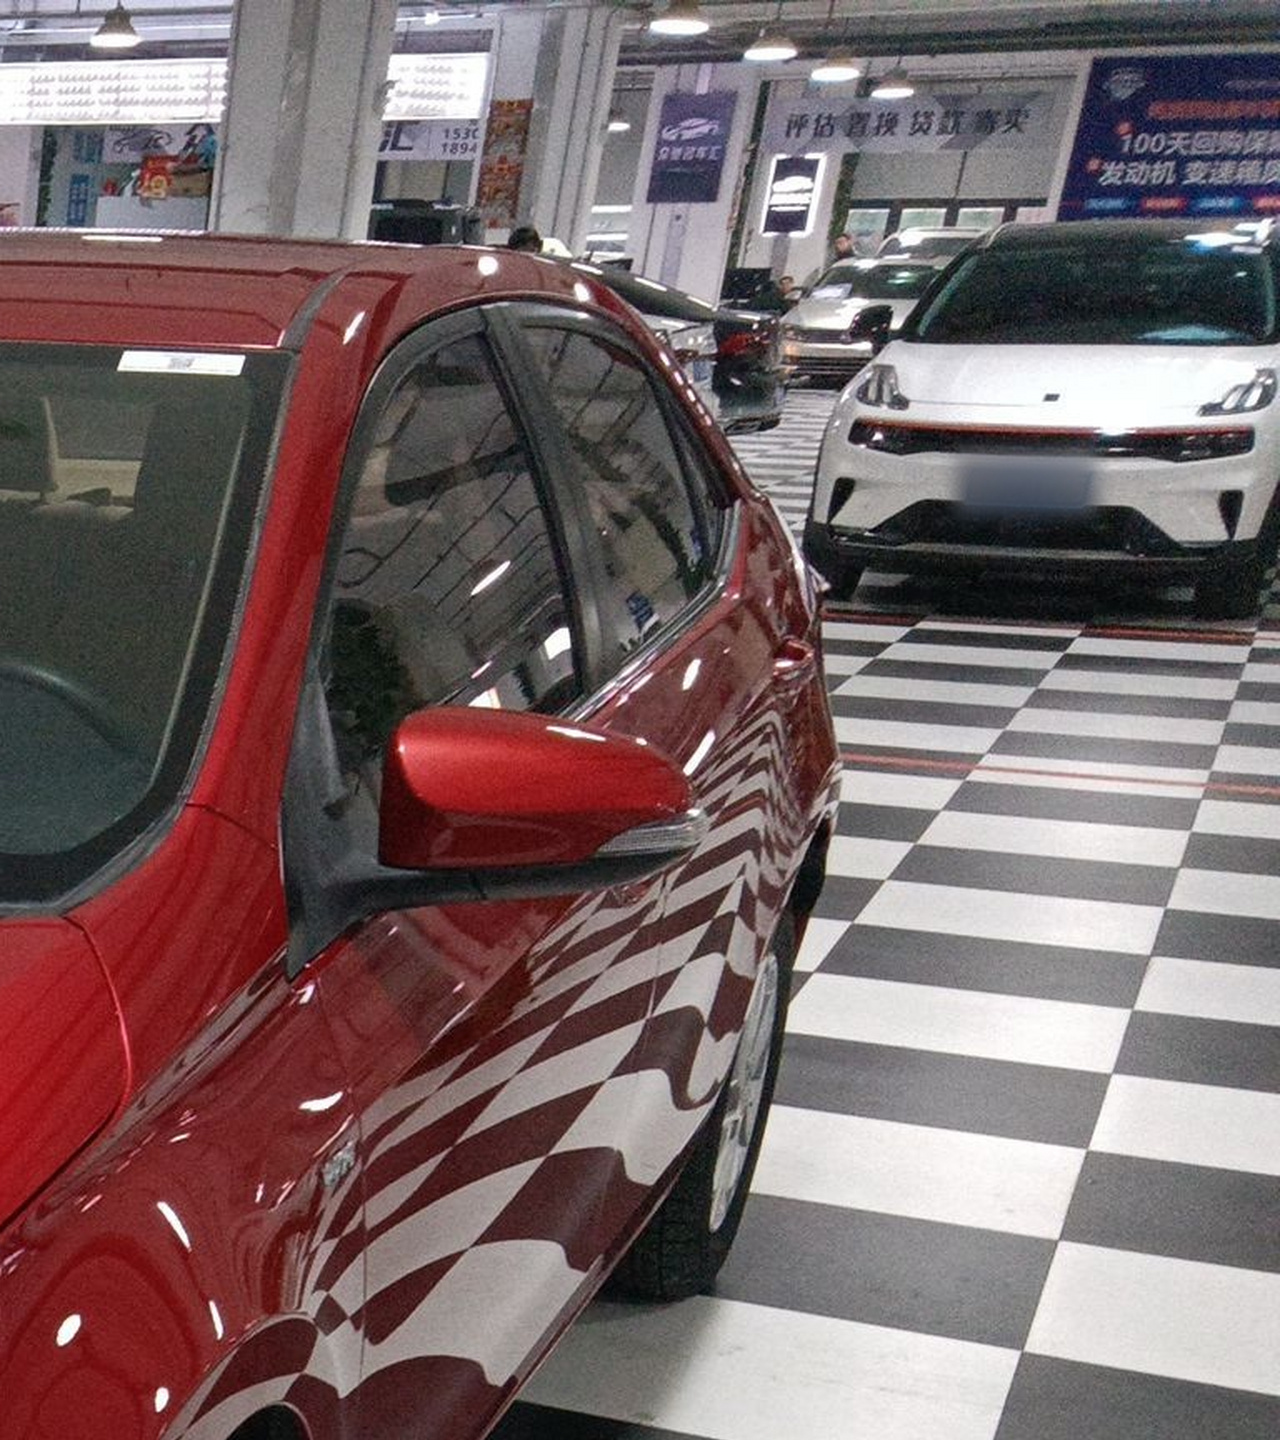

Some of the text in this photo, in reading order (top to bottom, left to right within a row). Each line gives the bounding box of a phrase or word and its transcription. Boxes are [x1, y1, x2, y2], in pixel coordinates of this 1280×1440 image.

[785, 113, 840, 138] 评估
[845, 112, 899, 137] 置换
[908, 110, 967, 136] 贷款
[1098, 159, 1177, 186] 发动机
